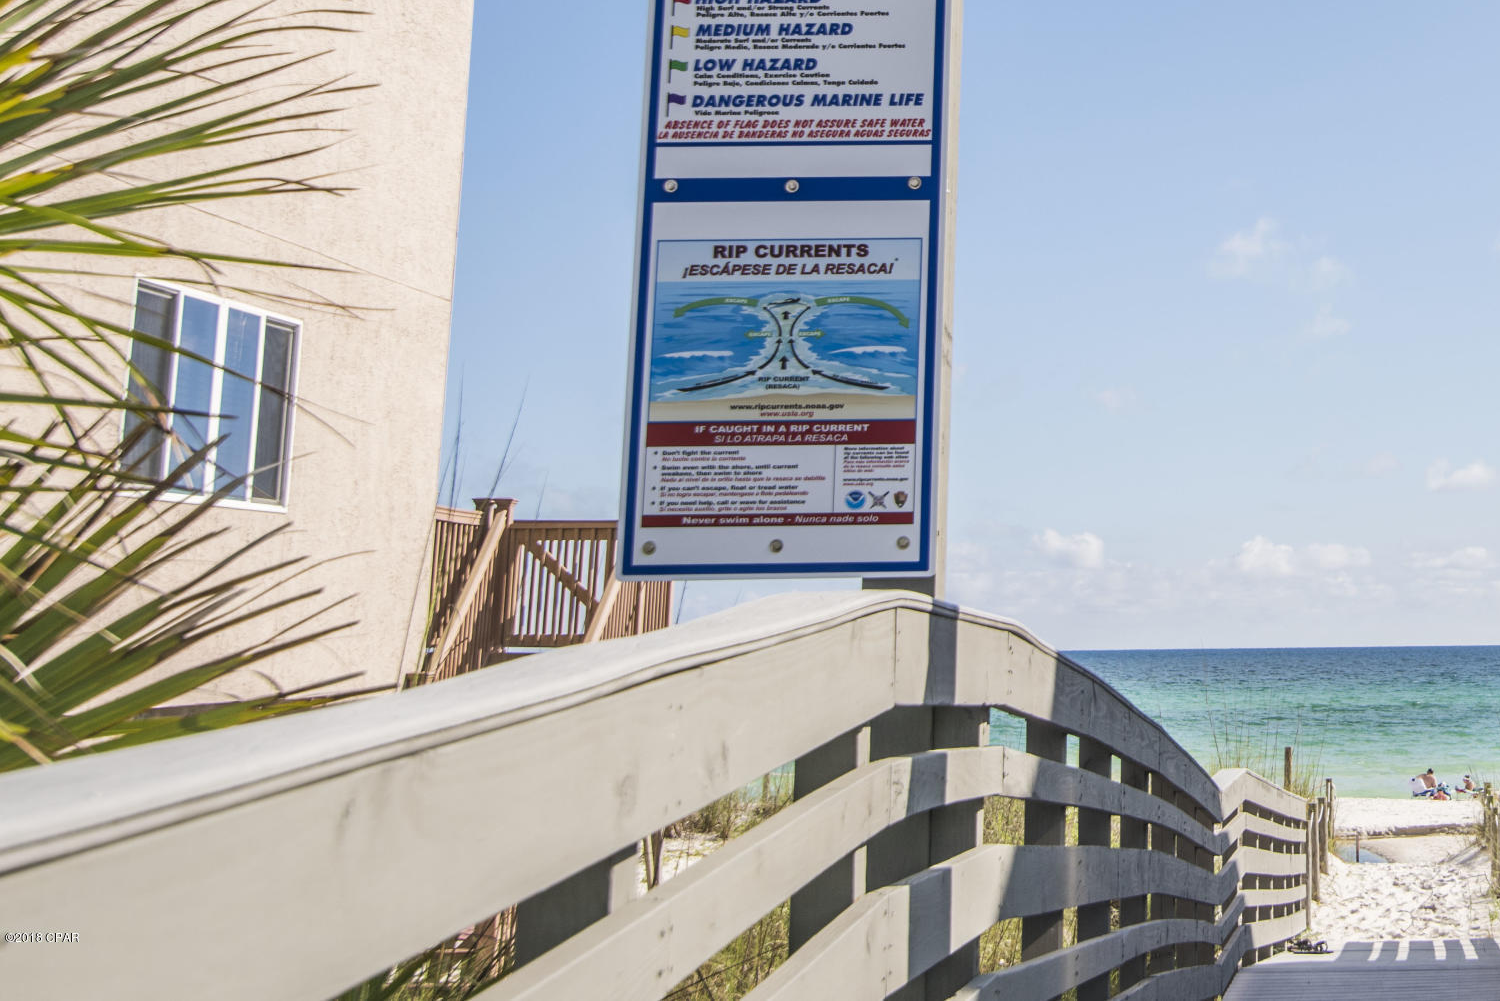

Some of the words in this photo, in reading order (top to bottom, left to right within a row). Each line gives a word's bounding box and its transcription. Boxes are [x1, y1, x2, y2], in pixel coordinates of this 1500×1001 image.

[695, 24, 771, 36] MEDIUM
[777, 23, 853, 36] HAZARD
[691, 59, 737, 71] LOW
[739, 58, 819, 71] HAZARD
[690, 94, 805, 108] DANGEROUS
[809, 93, 883, 107] MARINE
[888, 93, 924, 106] LIFE
[662, 120, 715, 129] ABSENCE
[714, 120, 732, 129] OF
[731, 120, 760, 129] FLAG
[759, 119, 792, 129] DOES
[791, 119, 815, 129] NOT
[814, 119, 859, 128] ASSURE
[858, 119, 888, 128] SAFE
[887, 119, 926, 128] WATER
[712, 245, 748, 259] RIP
[752, 244, 871, 259] CURRENTS
[681, 263, 773, 278] ¡ESCÁPESE
[773, 263, 798, 277] DE
[798, 263, 823, 276] LA
[822, 262, 894, 276] RESACA!
[758, 376, 773, 384] RIP
[773, 375, 810, 383] CURRENT
[729, 402, 845, 411] www.ripcurrents.noaa.gov
[694, 425, 706, 434] IF
[708, 425, 759, 433] CAUGHT
[761, 424, 775, 433] IN
[777, 424, 786, 433] A
[789, 424, 809, 433] RIP
[812, 424, 869, 433] CURRENT
[712, 435, 726, 443] SI
[725, 435, 743, 443] LO
[742, 434, 787, 443] ATRAPA
[786, 434, 803, 442] LA
[802, 434, 850, 442] RESACA
[679, 516, 717, 525] Never
[717, 515, 751, 525] swim
[751, 515, 786, 524] alone
[793, 514, 828, 524] Nunca
[828, 514, 856, 523] nade
[855, 513, 880, 523] solo
